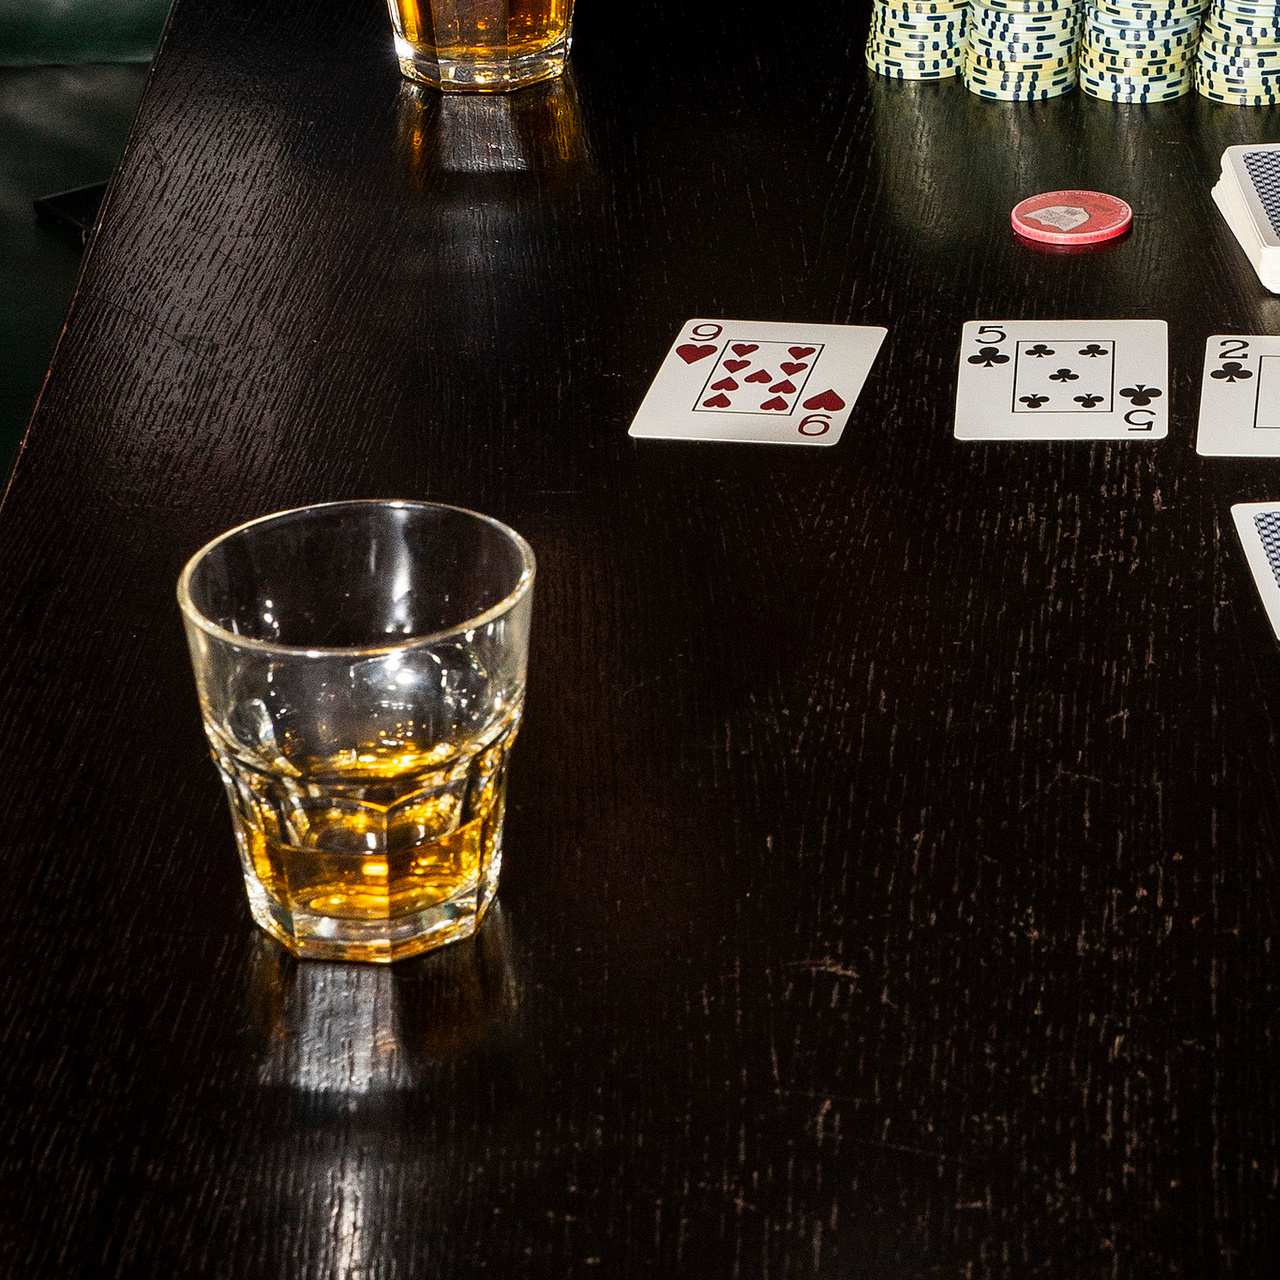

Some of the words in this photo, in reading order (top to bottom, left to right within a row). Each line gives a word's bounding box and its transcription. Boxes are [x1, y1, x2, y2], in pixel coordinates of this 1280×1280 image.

[690, 324, 722, 341] 9
[975, 326, 1006, 344] 5
[1219, 340, 1249, 358] 2
[798, 414, 832, 436] 9
[1124, 410, 1156, 431] 5
